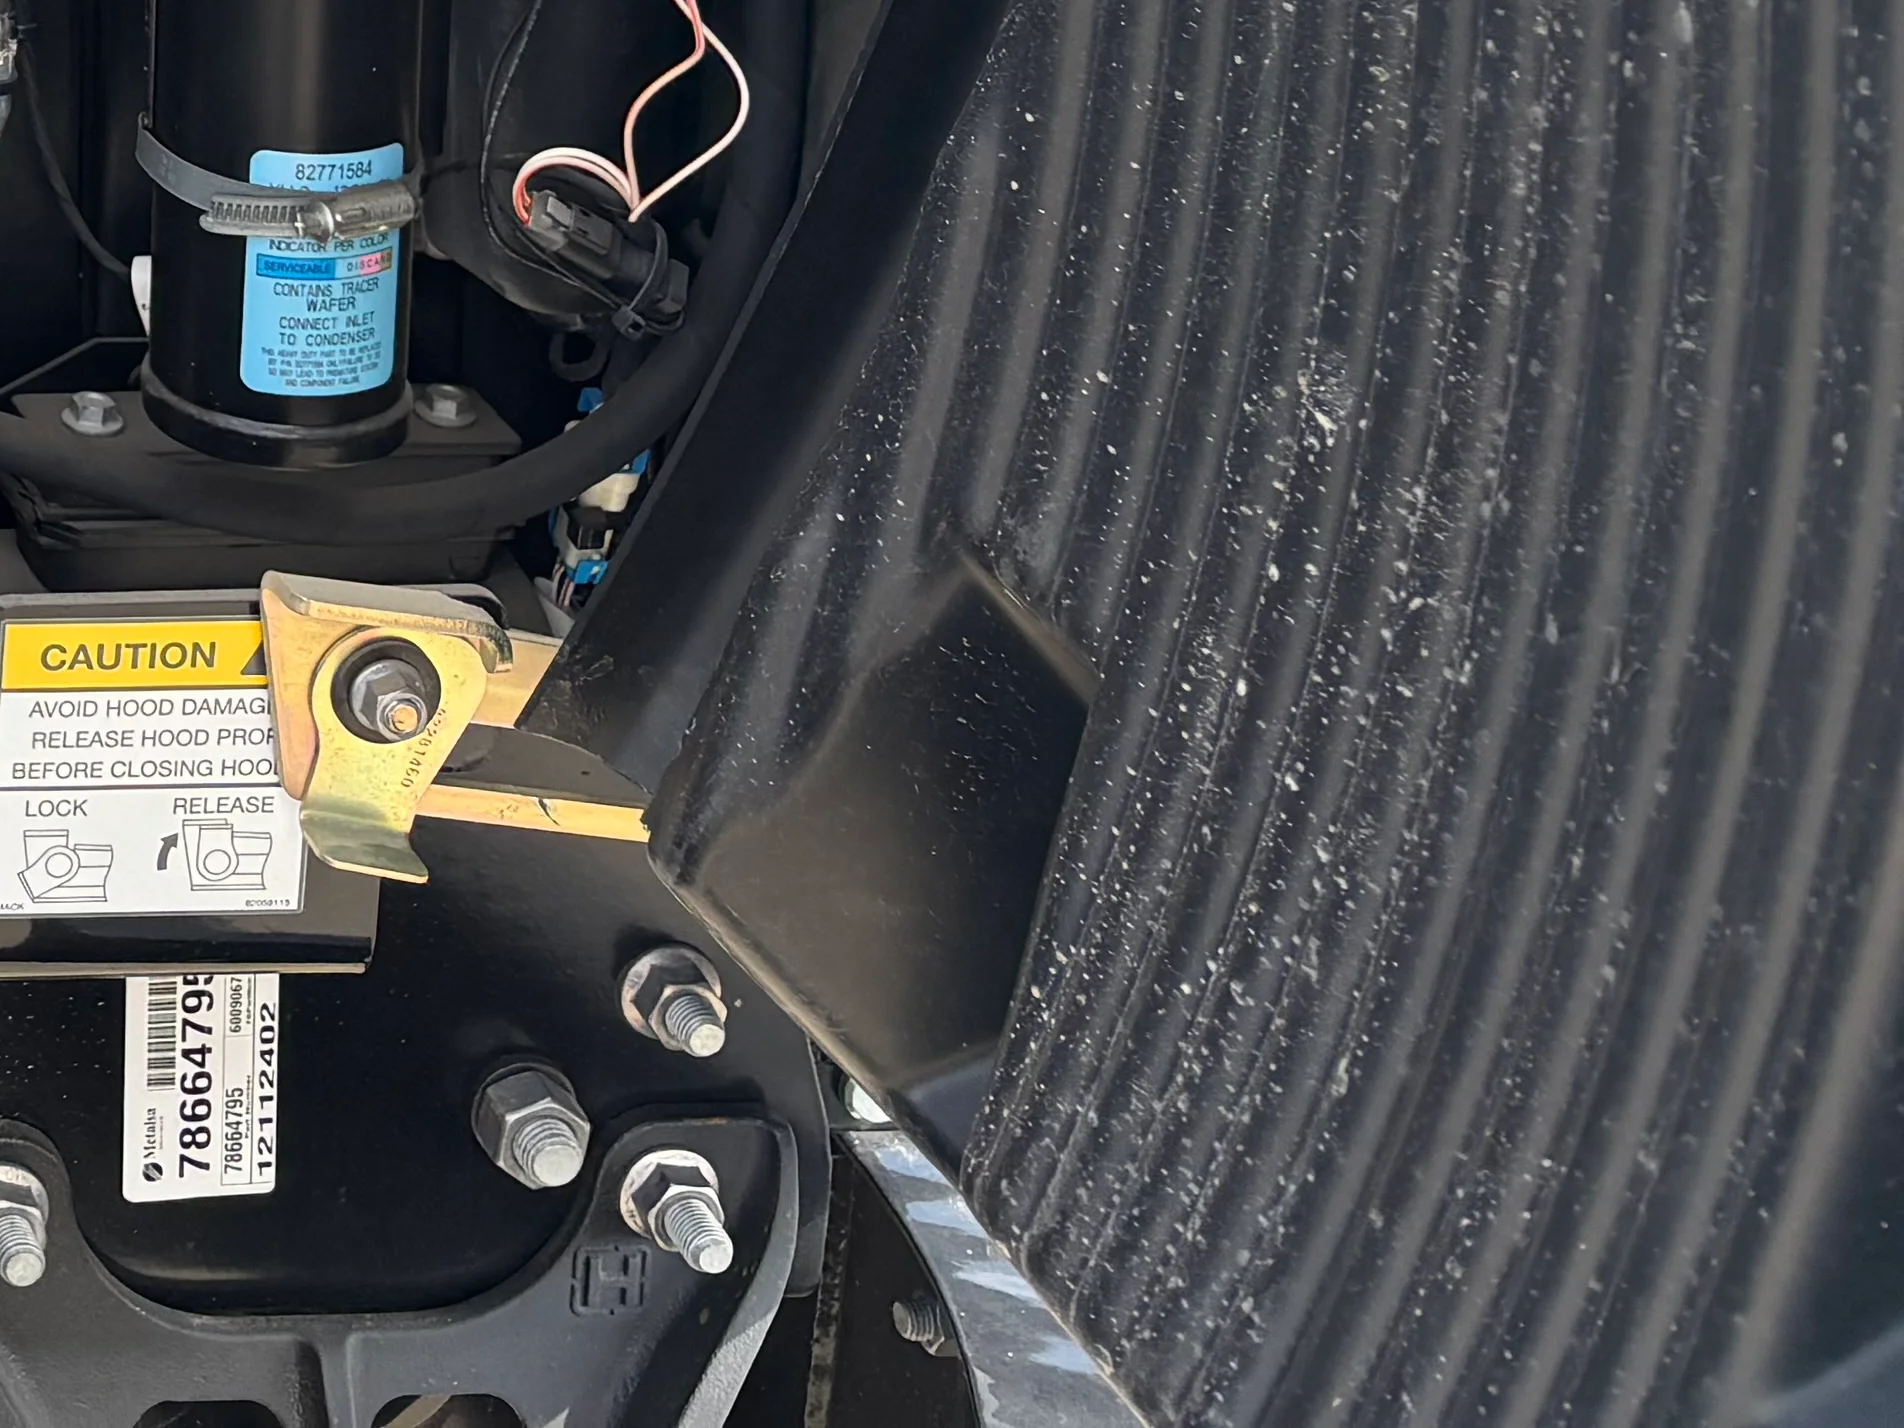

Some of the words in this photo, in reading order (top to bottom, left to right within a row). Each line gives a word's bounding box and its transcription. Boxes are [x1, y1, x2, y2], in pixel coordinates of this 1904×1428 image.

[295, 160, 372, 181] 82771584
[269, 239, 326, 253] INDICATOR
[334, 240, 354, 252] PER
[359, 233, 389, 249] COLOR
[264, 260, 331, 274] SERVICEABLE
[273, 282, 333, 297] CONTAINS
[341, 277, 380, 294] TRACER
[306, 296, 356, 312] WAFER
[279, 316, 338, 330] CONNECT
[345, 311, 375, 328] INLET
[279, 332, 297, 345] TO
[305, 328, 376, 346] CONDENSER
[41, 641, 216, 672] CAUTION
[29, 700, 98, 719] AVOID
[106, 699, 174, 717] HOOD
[32, 730, 134, 750] RELEASE
[141, 729, 209, 748] HOOD
[12, 762, 104, 780] BEFORE
[110, 760, 214, 778] CLOSING
[25, 800, 88, 818] LOCK
[173, 796, 275, 815] RELEASE
[229, 976, 243, 1033] 6009067
[258, 1002, 276, 1176] 12112402
[143, 1108, 157, 1159] Metalsa
[224, 1087, 243, 1174] 78664795
